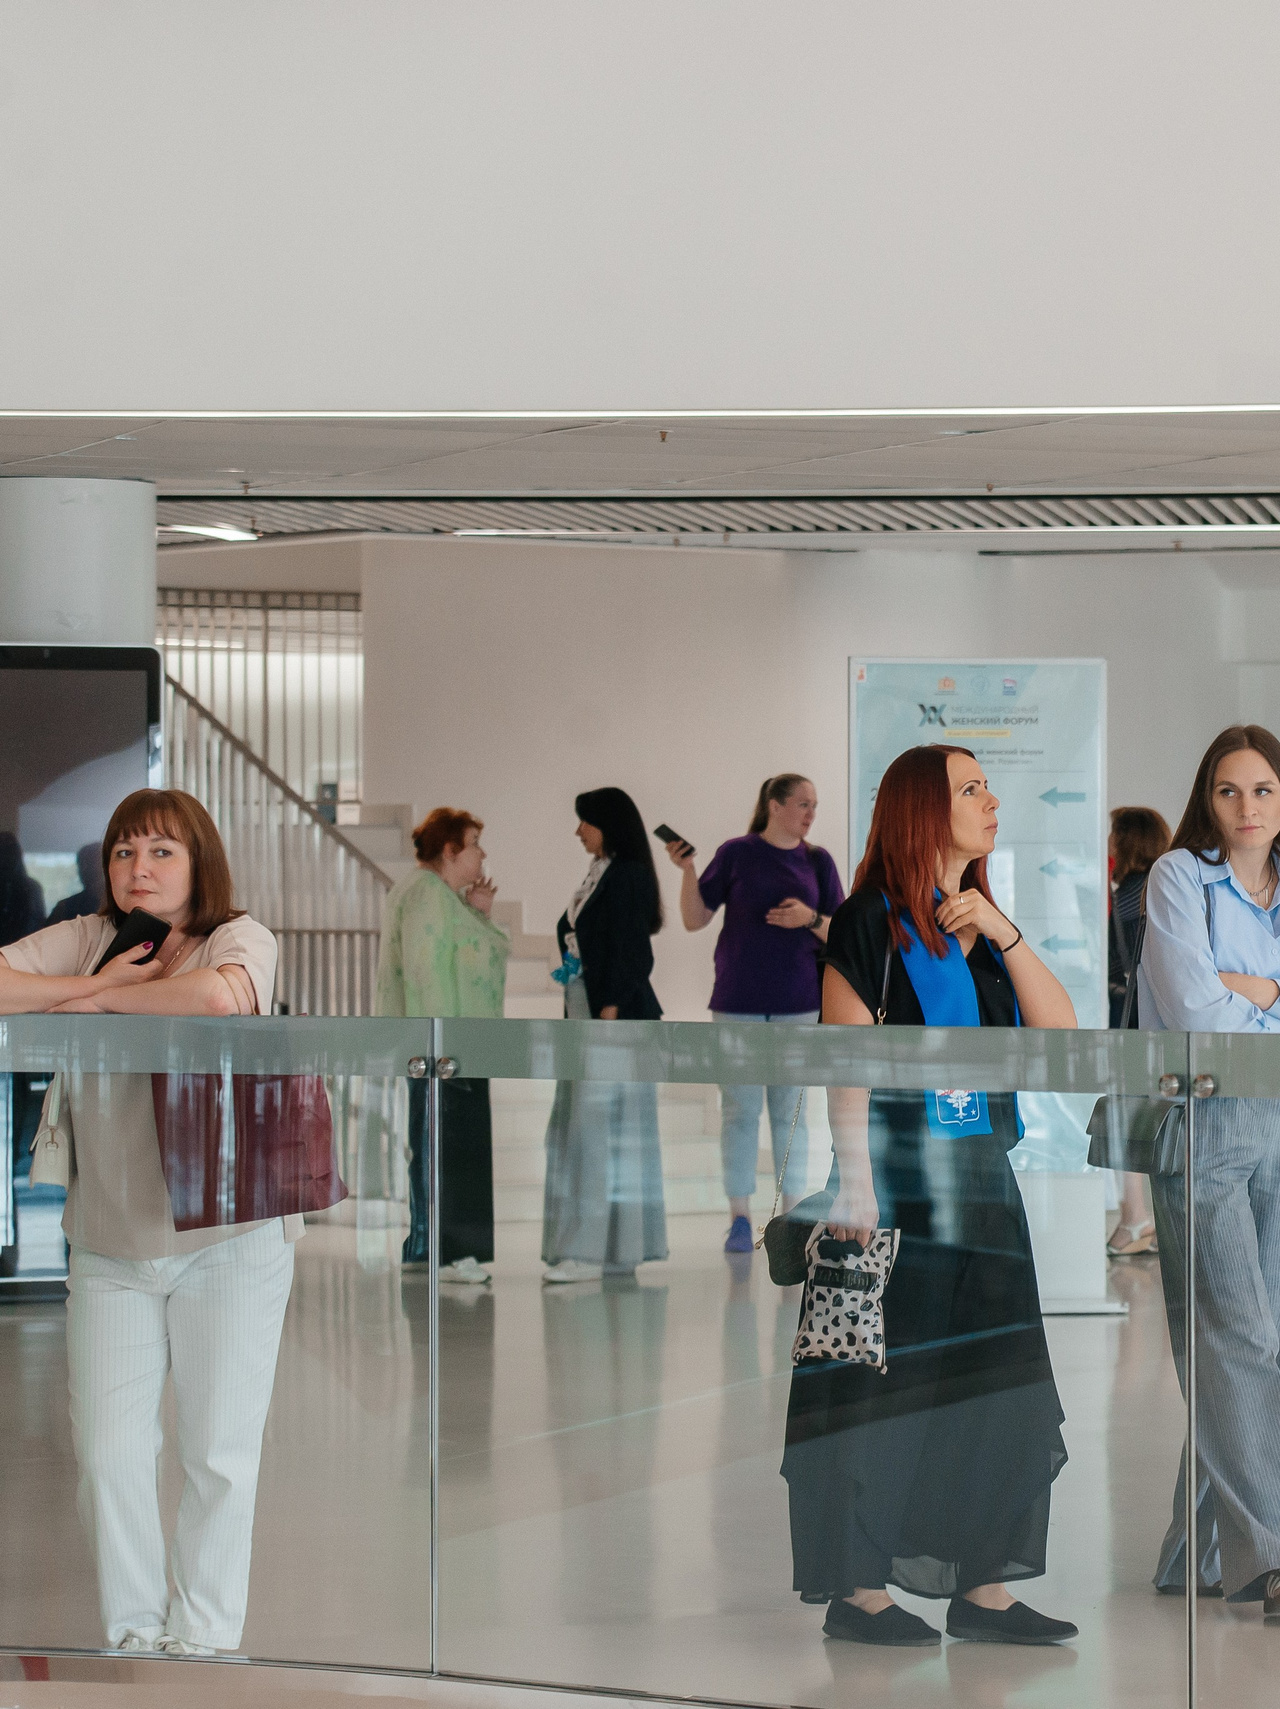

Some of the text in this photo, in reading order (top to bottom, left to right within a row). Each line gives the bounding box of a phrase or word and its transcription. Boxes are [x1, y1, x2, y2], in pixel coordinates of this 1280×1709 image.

[951, 704, 1039, 715] МЕЖДУНАРОДНЫЙ
[951, 715, 1039, 726] ЖЕНСКИЙ ФОРУМ
